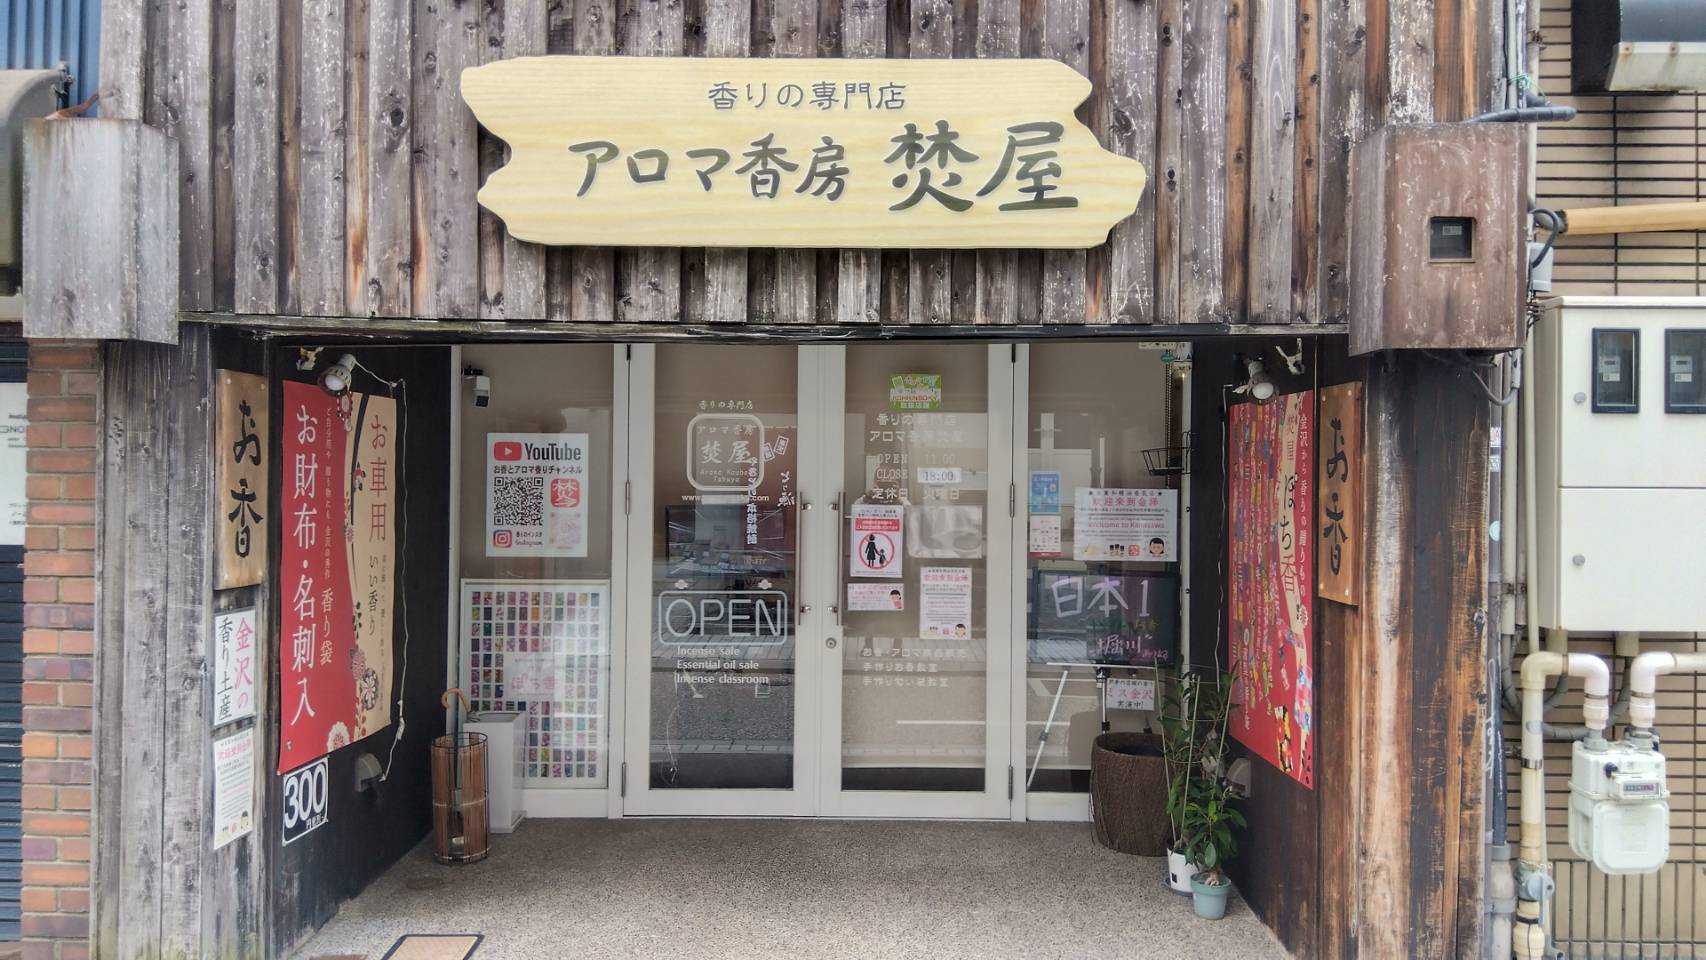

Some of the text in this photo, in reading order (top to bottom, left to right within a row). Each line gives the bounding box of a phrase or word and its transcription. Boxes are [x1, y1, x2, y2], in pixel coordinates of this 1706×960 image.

[707, 81, 907, 111] 香りの専門店
[567, 119, 1080, 213] アロマ香房 焚屋
[699, 400, 754, 410] 香りの専門店
[524, 442, 582, 461] YouTube
[701, 440, 757, 464] 焚屋
[877, 453, 909, 464] OPEN
[228, 400, 264, 558] お香
[369, 413, 388, 543] お車用
[493, 465, 583, 475] お香とアロマ香りチャンネル
[876, 468, 954, 481] CLOSE 18:00
[872, 487, 909, 500] 定休日
[1323, 416, 1349, 576] お香
[291, 404, 318, 726] お財布・名刺入
[320, 587, 334, 665] 香り袋
[665, 598, 782, 637] OPEN
[234, 616, 254, 710] 金沢の
[676, 659, 760, 670] Essential oil sale
[677, 646, 740, 656] Incense sale
[217, 616, 233, 721] 香り土産
[676, 673, 769, 684] Incense classroom
[284, 763, 326, 829] 300
